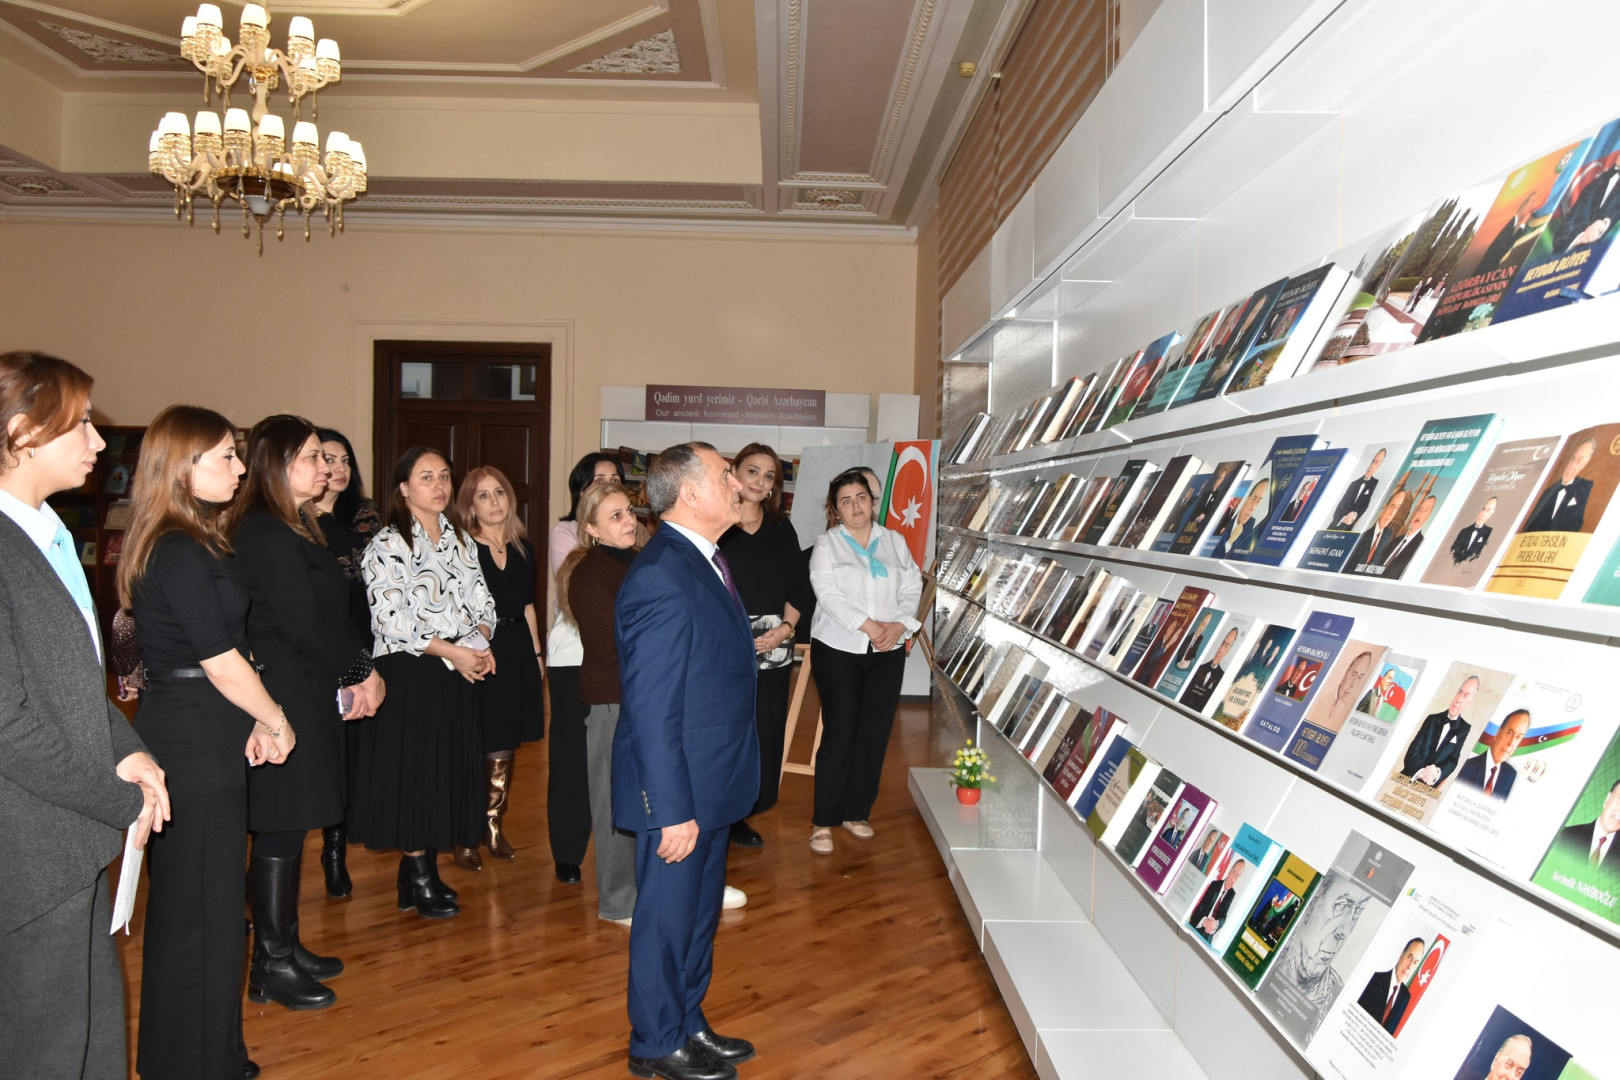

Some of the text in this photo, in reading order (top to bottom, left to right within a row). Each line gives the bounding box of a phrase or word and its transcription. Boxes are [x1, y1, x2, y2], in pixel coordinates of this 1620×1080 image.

[654, 391, 680, 405] Qədim
[684, 393, 703, 407] yurd
[706, 393, 736, 407] yerimiz
[746, 394, 769, 407] Qərbi
[773, 395, 818, 410] Azərbaycan
[655, 409, 670, 417] Our
[673, 409, 700, 417] ancient
[1515, 549, 1559, 564] PROBLEMLƏRİ
[1259, 719, 1281, 733] KATALOG
